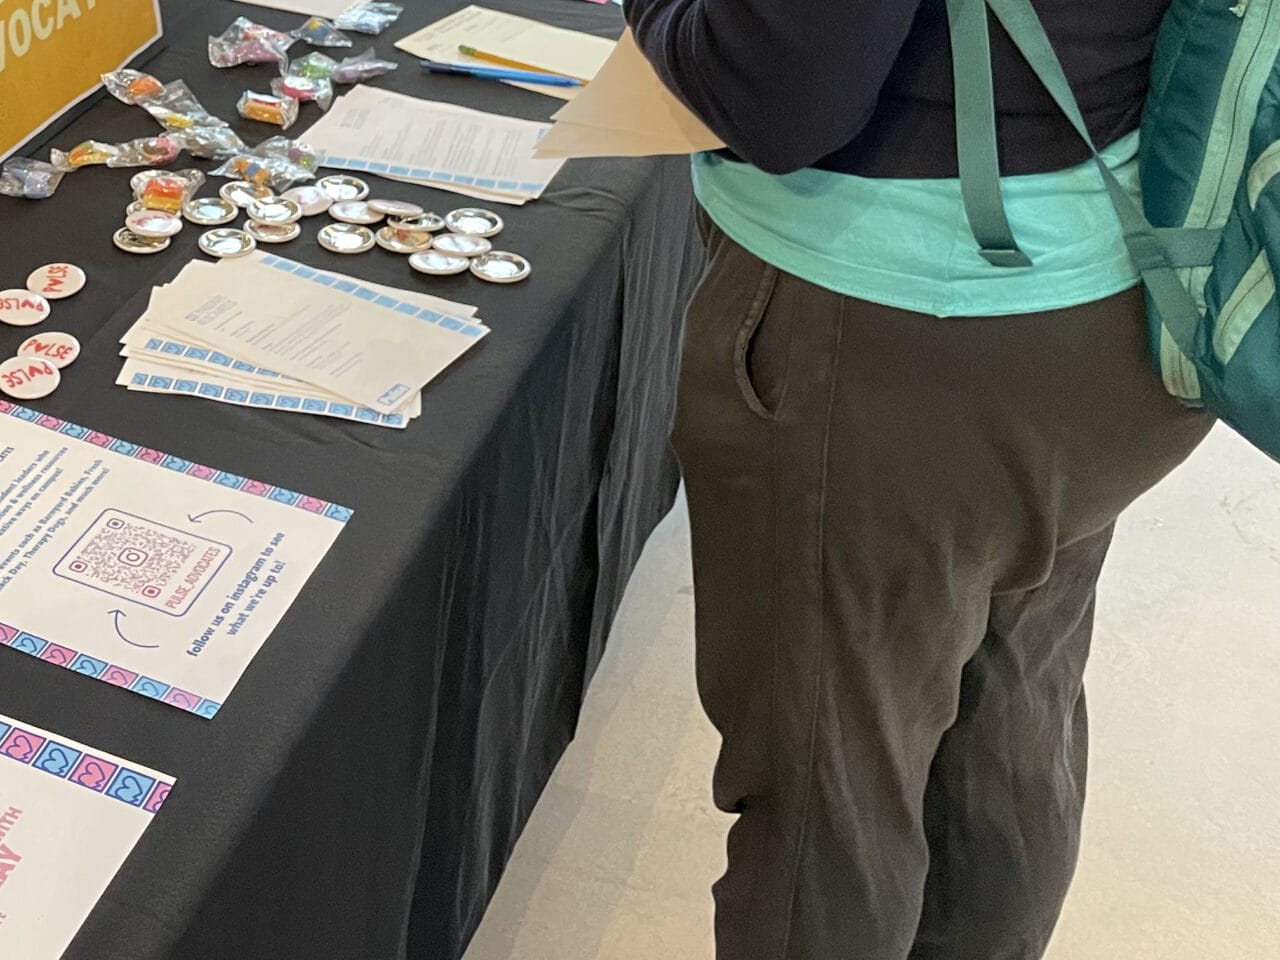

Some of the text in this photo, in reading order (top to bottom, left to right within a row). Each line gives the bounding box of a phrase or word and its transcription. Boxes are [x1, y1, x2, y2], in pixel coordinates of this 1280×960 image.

[268, 560, 286, 574] to!
[261, 574, 278, 588] up
[186, 532, 285, 657] follow us on instagram to see
[225, 612, 250, 636] what
